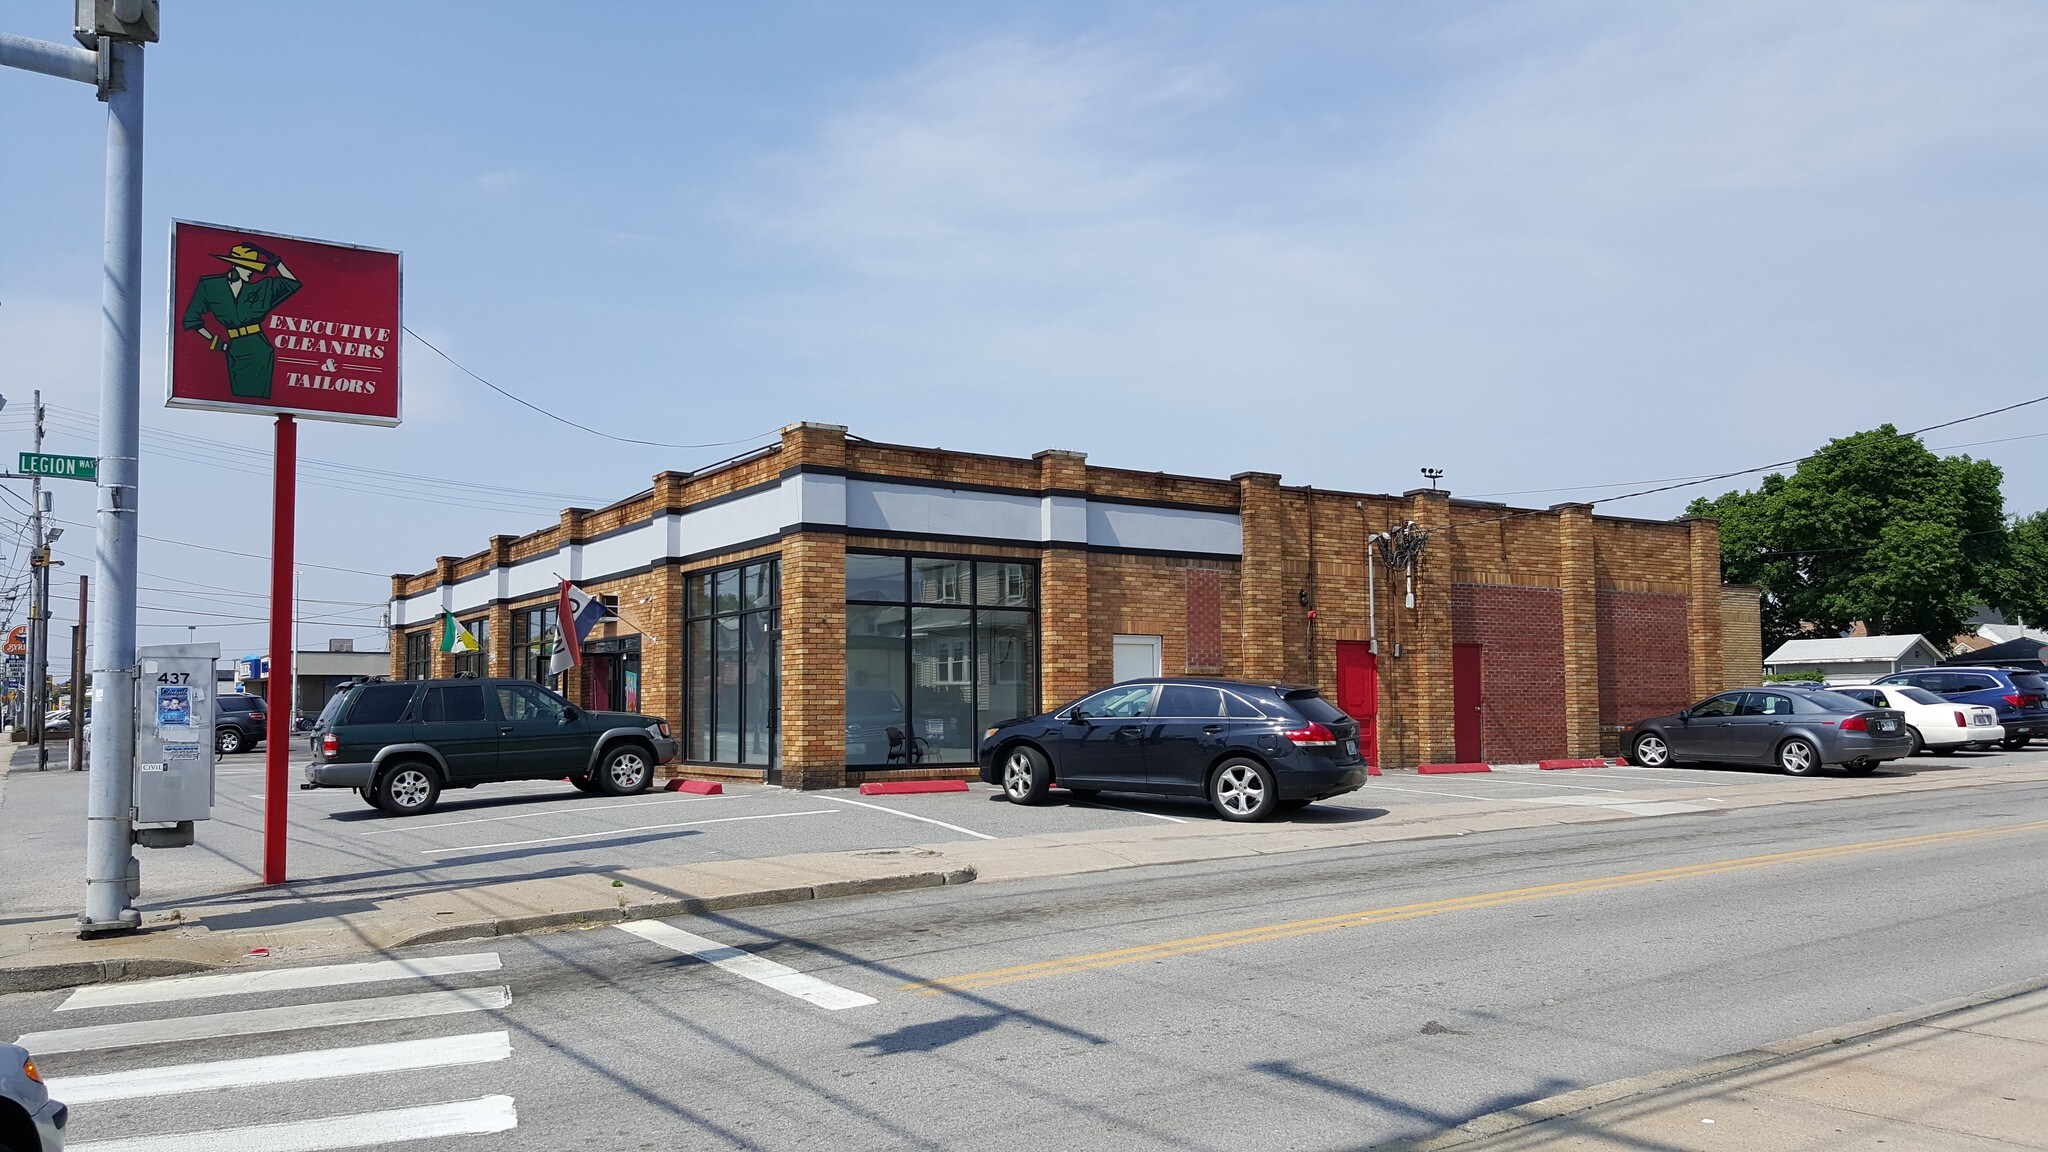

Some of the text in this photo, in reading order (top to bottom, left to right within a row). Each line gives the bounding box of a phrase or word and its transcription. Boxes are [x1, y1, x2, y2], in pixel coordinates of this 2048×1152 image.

[268, 315, 391, 342] EXECUTIVE
[274, 335, 385, 359] CLEANERS
[321, 358, 338, 373] &
[287, 372, 376, 394] TAILORS
[21, 455, 95, 475] LEGION WAY
[7, 643, 26, 653] BYRI
[157, 672, 191, 685] 437
